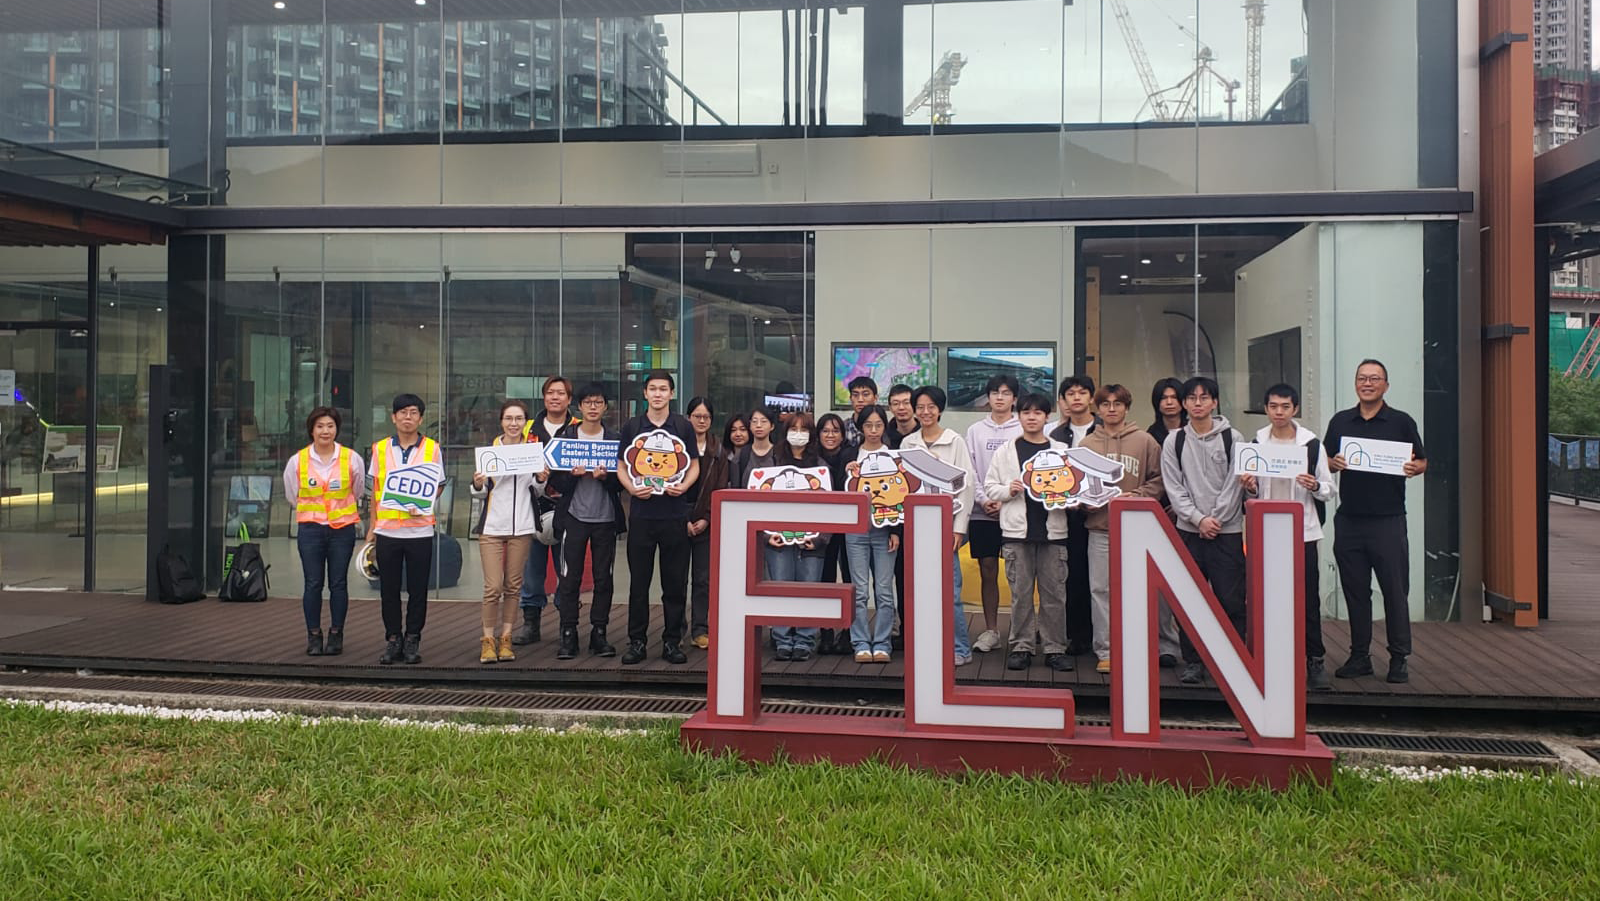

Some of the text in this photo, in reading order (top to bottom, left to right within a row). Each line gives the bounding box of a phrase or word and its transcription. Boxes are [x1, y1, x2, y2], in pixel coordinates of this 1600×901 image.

[561, 442, 619, 451] Fanling Bypass
[386, 475, 435, 498] CEDD
[707, 490, 1306, 750] FLN
